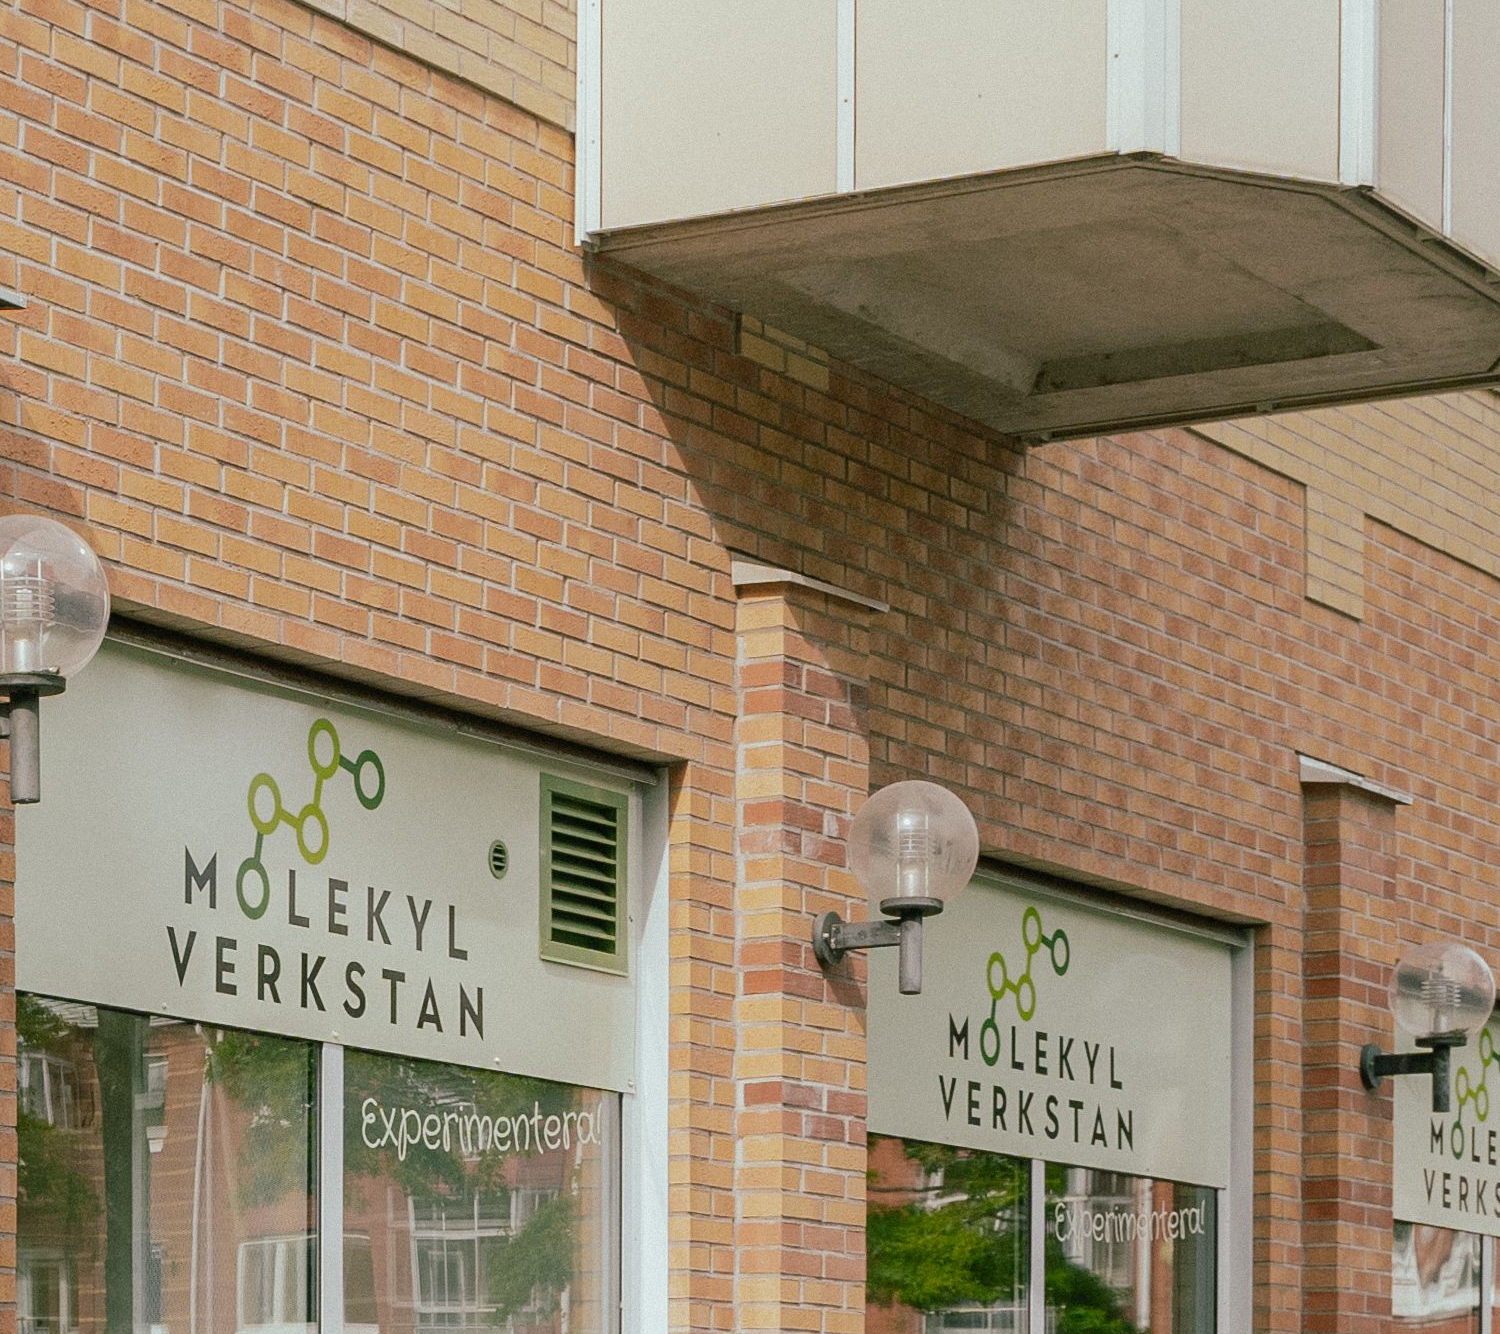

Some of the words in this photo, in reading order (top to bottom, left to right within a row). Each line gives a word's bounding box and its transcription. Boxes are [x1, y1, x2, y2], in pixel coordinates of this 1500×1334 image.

[184, 843, 469, 962] MOLEKYL
[166, 925, 485, 1041] VERKSTAN
[948, 1012, 1123, 1091] MOLEKYL
[360, 1097, 602, 1161] Experimentera!
[938, 1074, 1134, 1152] VERKSTAN
[1054, 1199, 1206, 1249] Experimentera!
